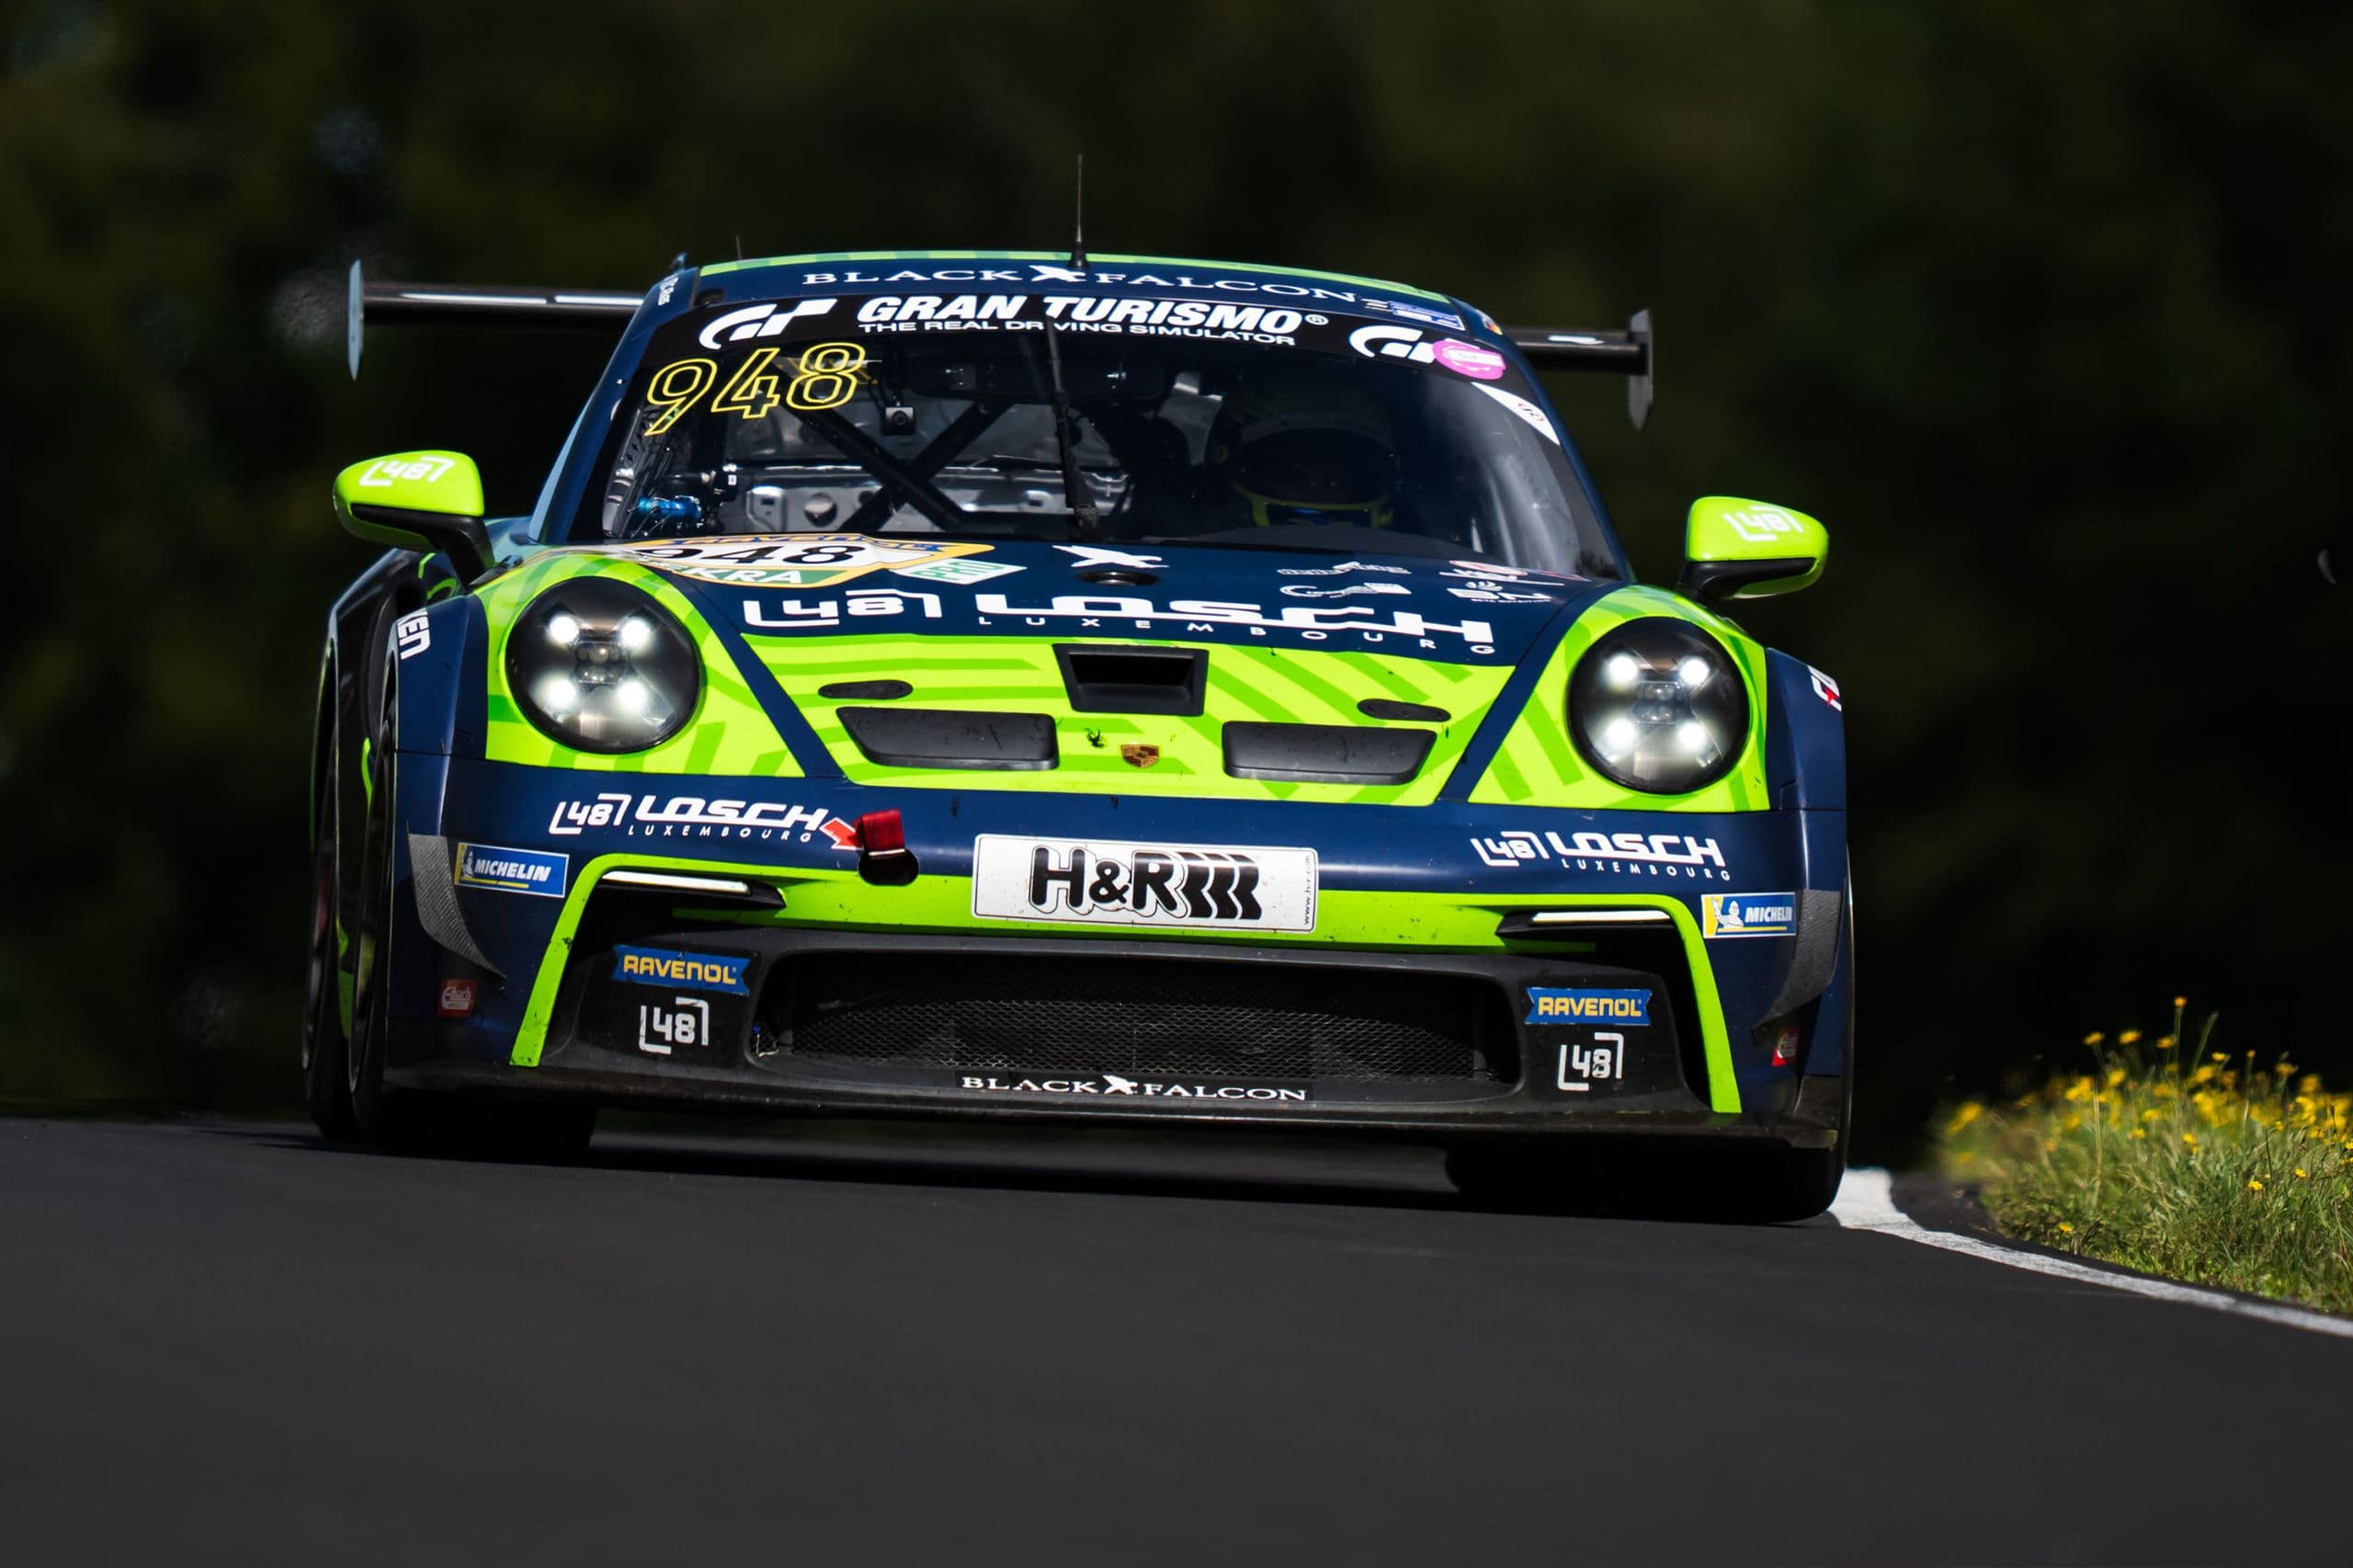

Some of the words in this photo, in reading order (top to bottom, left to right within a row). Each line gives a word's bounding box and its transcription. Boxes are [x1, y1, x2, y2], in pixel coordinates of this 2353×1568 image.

[802, 269, 1023, 285] BLACK
[1096, 272, 1358, 302] FALCON
[857, 295, 1028, 323] GRAN
[858, 322, 917, 333] THE
[925, 321, 999, 331] REAL
[1005, 321, 1122, 334] DRVING
[1129, 325, 1296, 347] SIMULATOR
[644, 341, 866, 437] 948
[397, 608, 431, 661] EN
[975, 594, 1494, 644] LOSCH
[978, 617, 1496, 655] LUXEMBOURG
[635, 795, 829, 832] LOSCH
[628, 825, 813, 843] LUXEMBOURG
[1545, 832, 1725, 868] LOSCH
[474, 858, 551, 882] MICHELIN
[1030, 846, 1182, 915] H&R
[1562, 858, 1731, 881] LUXEMBOURG
[1745, 906, 1793, 923] MICHELIN
[961, 1076, 1099, 1094] BLACK
[1143, 1082, 1306, 1102] FALCON
